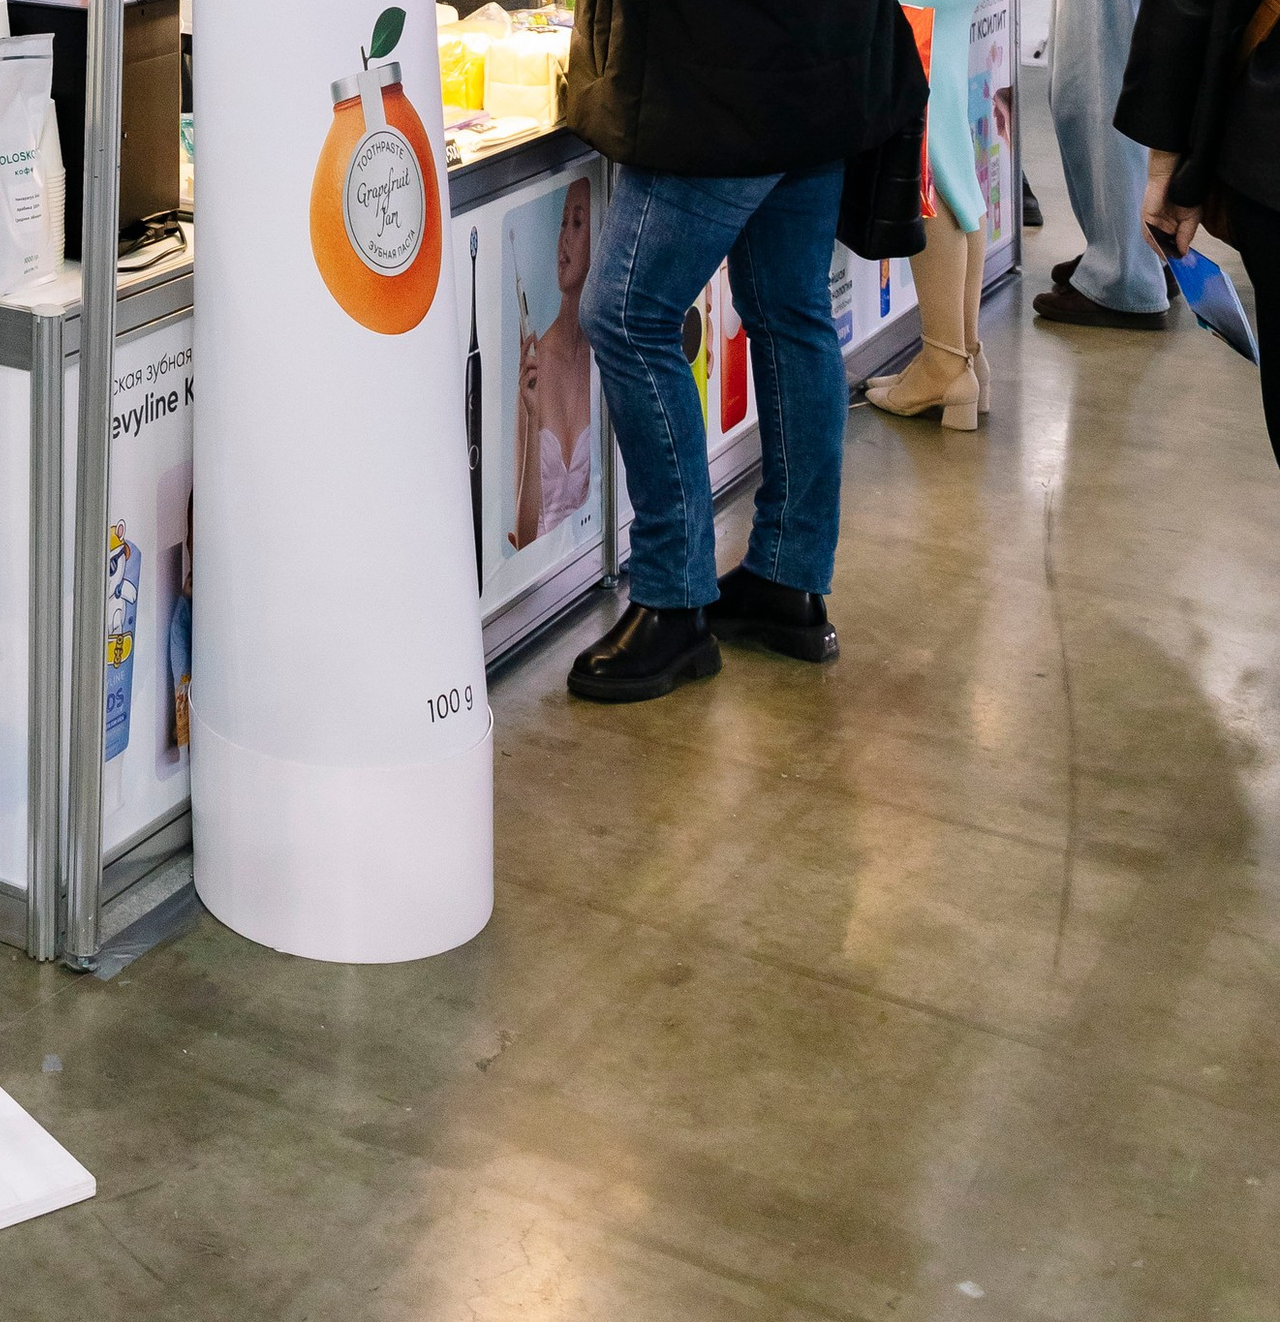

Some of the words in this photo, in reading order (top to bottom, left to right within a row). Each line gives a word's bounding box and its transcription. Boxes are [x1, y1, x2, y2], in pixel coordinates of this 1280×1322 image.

[977, 9, 1007, 41] КСИЛИТ
[357, 140, 405, 172] TOOTHPASTE
[357, 167, 411, 219] Grapefruit
[377, 206, 402, 237] Jam
[368, 240, 397, 260] ЗУБНАЯ
[397, 229, 416, 256] ПАСТА
[146, 347, 193, 383] зубная
[426, 692, 461, 724] 100
[463, 684, 474, 711] g
